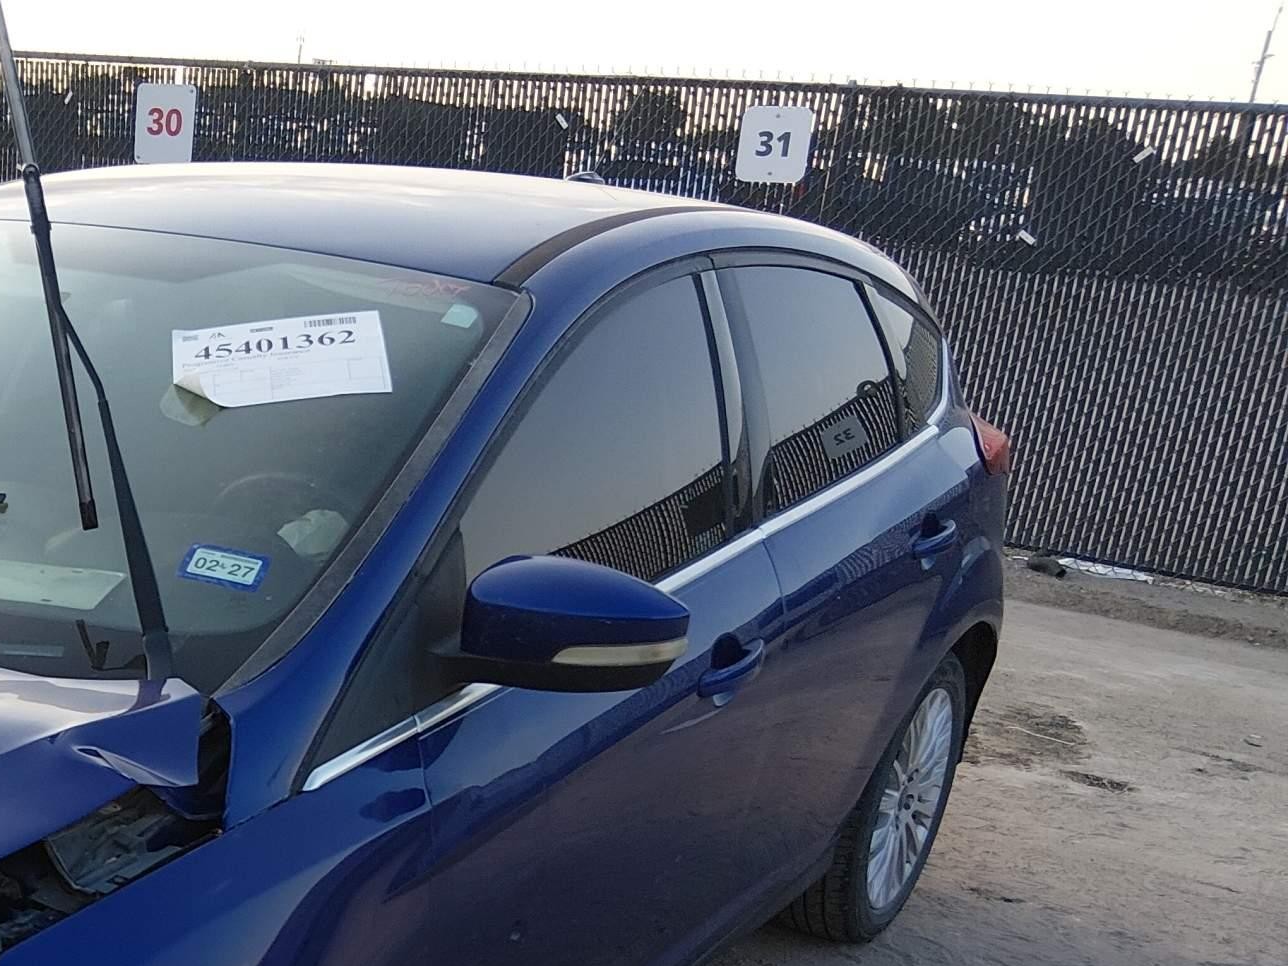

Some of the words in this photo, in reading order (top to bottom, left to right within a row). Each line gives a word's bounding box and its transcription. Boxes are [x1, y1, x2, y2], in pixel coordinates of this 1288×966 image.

[146, 107, 183, 137] 30
[754, 130, 792, 158] 31
[194, 329, 357, 361] 45401362
